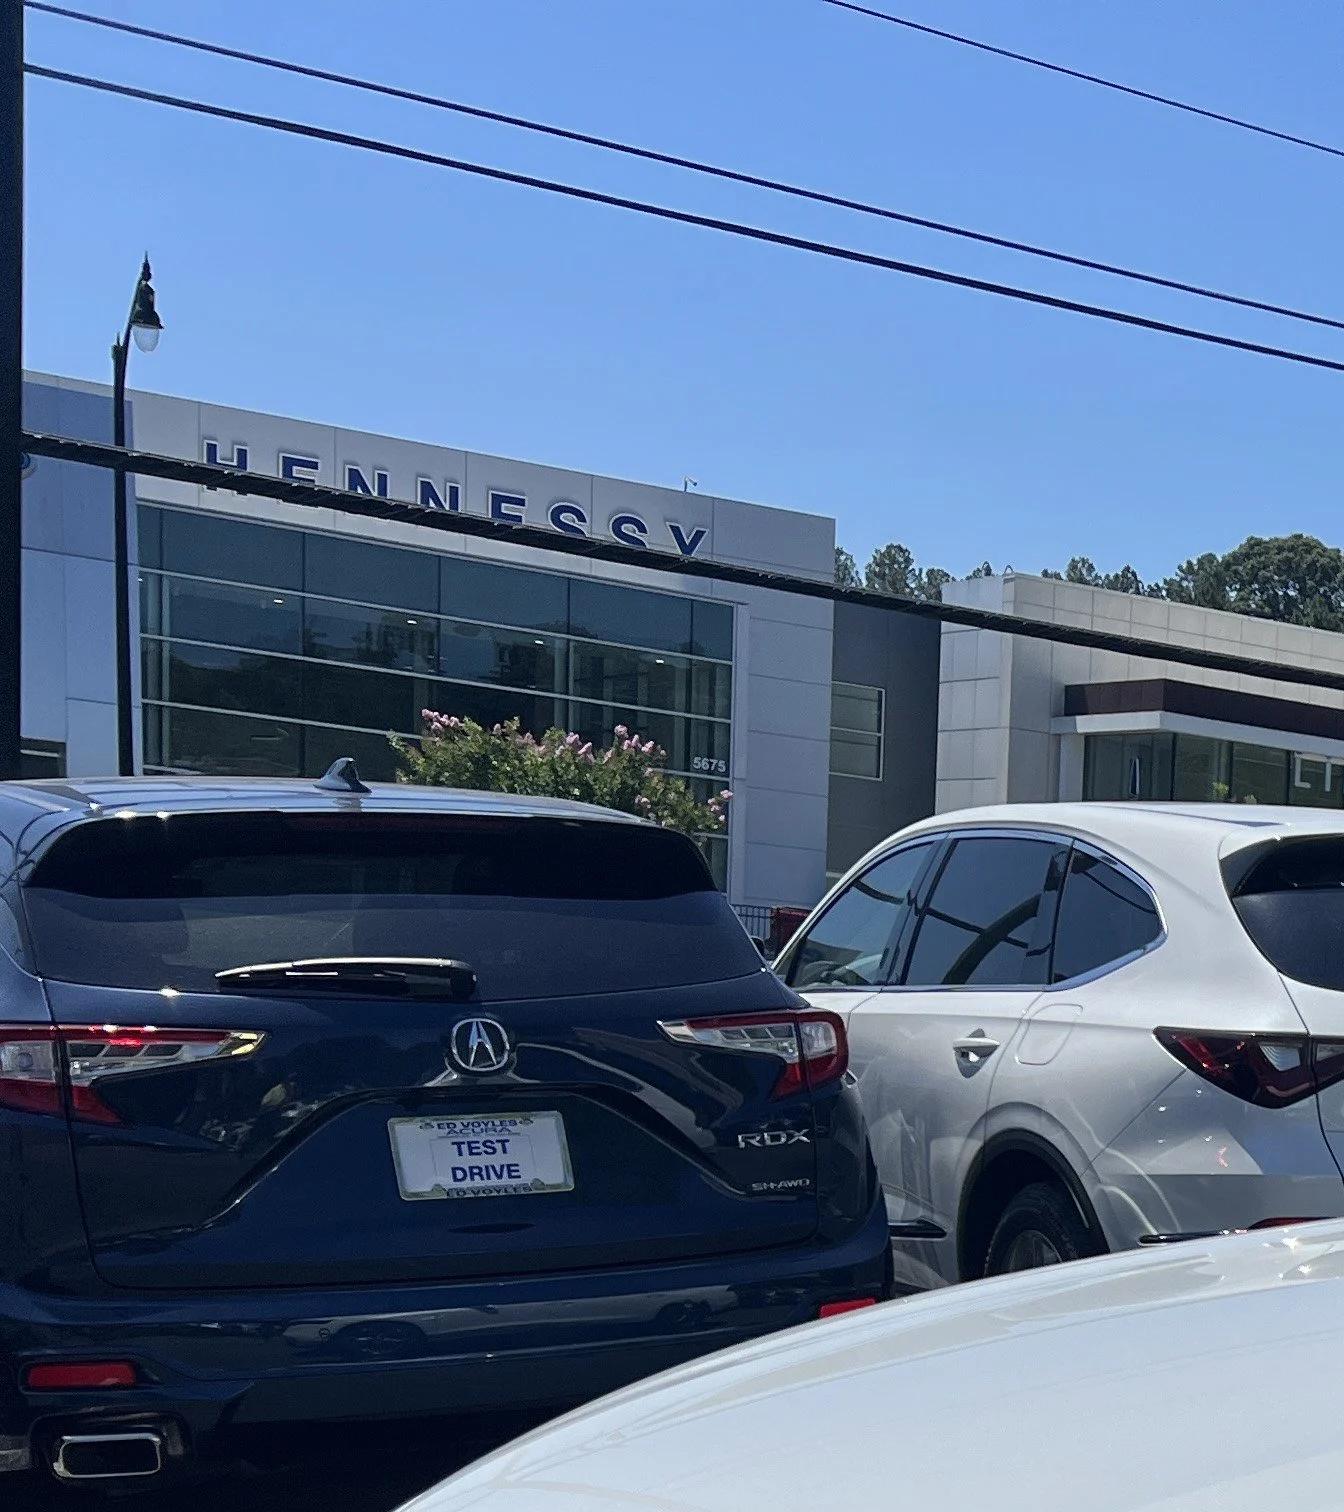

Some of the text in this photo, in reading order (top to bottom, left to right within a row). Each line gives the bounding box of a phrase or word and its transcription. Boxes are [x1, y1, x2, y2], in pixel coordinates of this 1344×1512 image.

[203, 439, 709, 558] HENNESSY
[693, 756, 726, 772] 5675
[437, 1119, 518, 1130] ED VOYLES
[446, 1127, 513, 1136] ACURA
[451, 1138, 510, 1157] TEST
[738, 1128, 811, 1148] RDX
[451, 1163, 522, 1183] DRIVE
